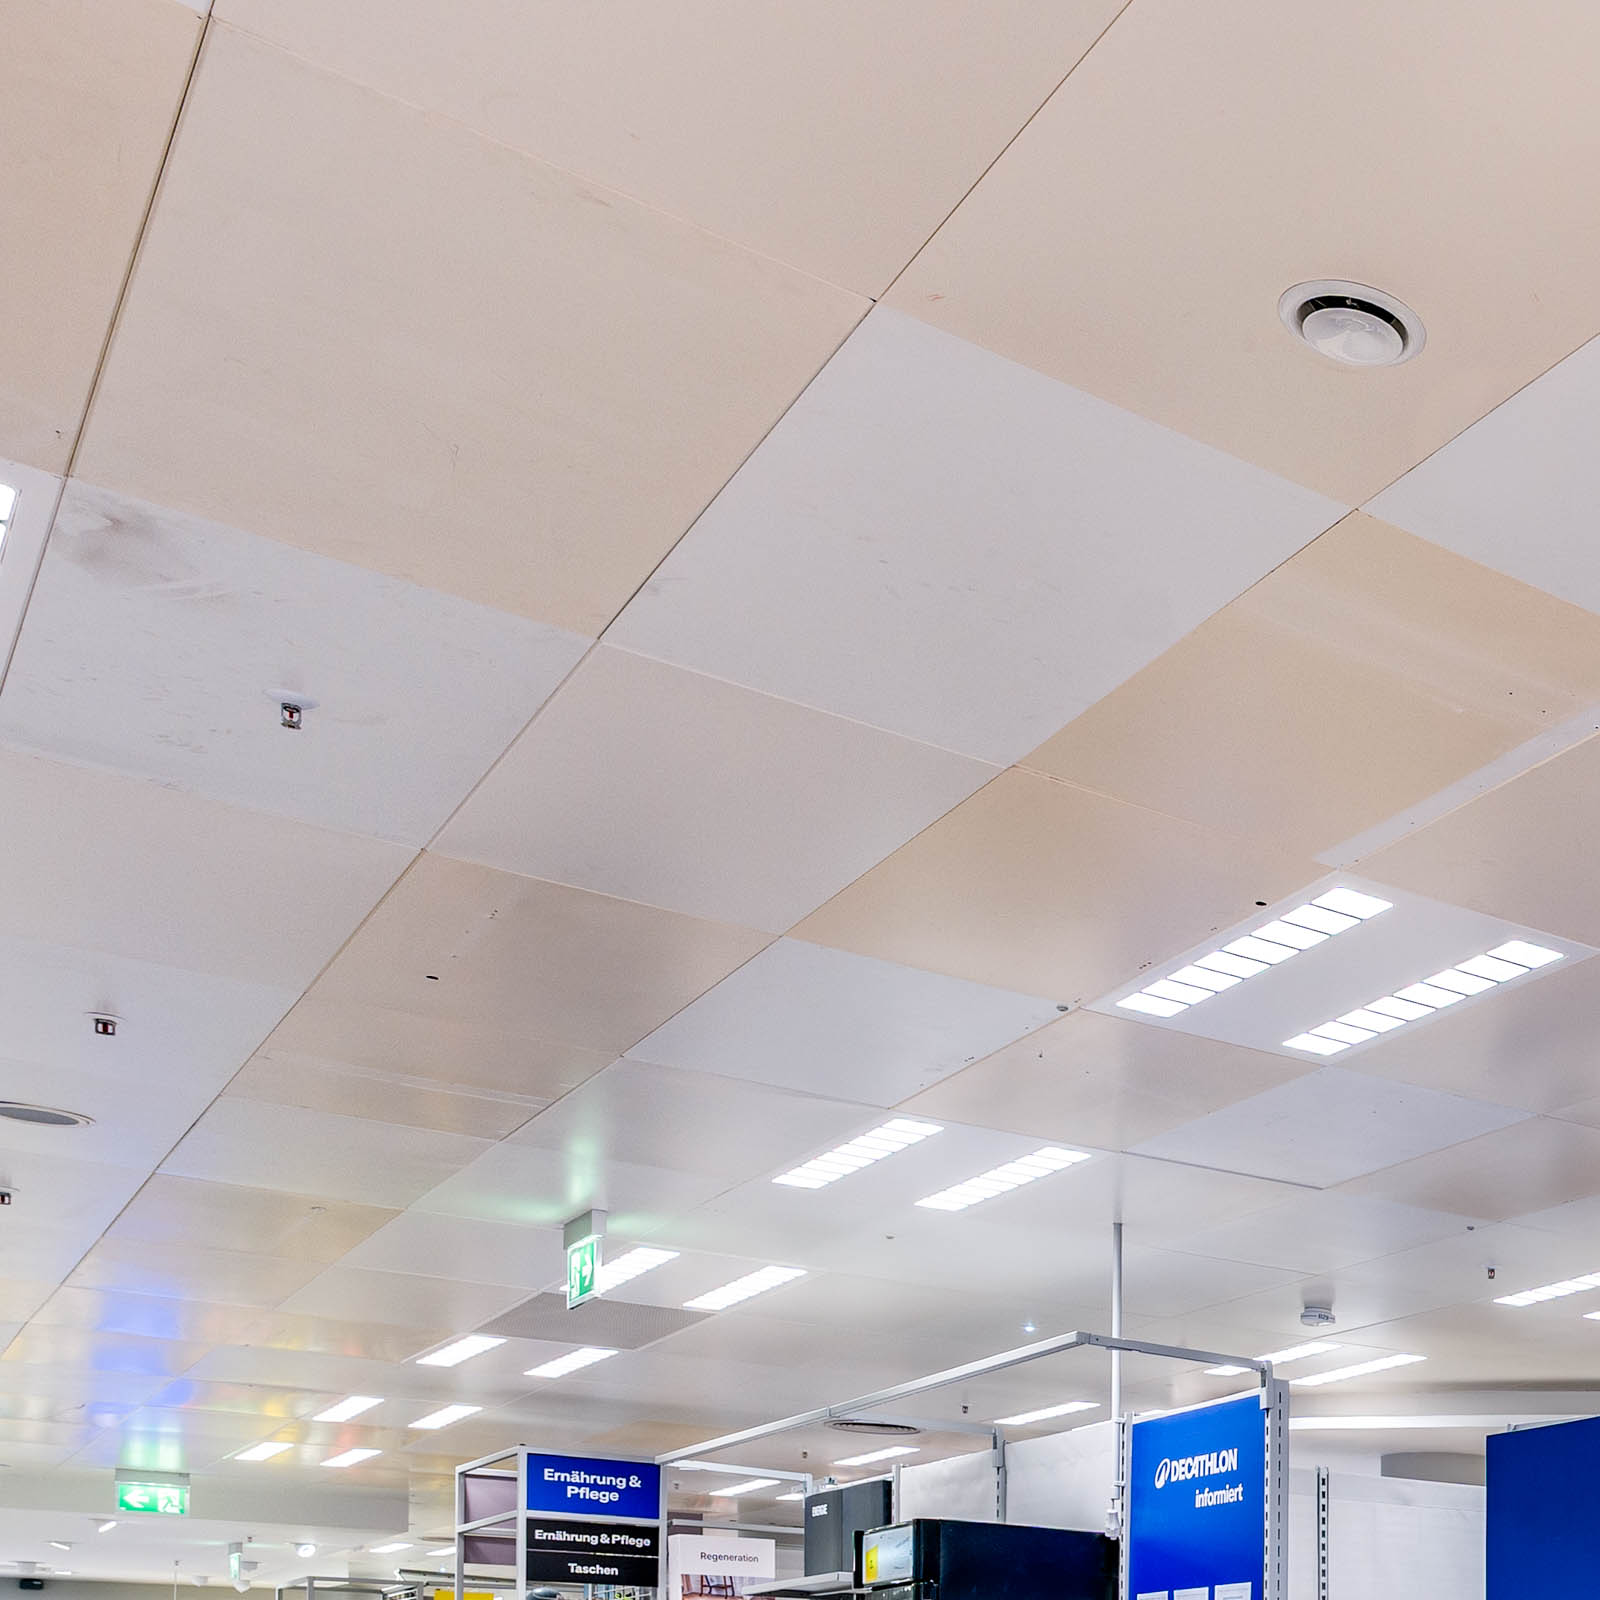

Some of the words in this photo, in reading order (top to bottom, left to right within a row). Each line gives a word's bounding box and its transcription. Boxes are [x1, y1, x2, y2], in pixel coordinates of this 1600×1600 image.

[1170, 1448, 1238, 1482] DECATHLON
[543, 1468, 627, 1489] Ernährung
[629, 1475, 642, 1488] &
[567, 1486, 620, 1503] Pflege
[1195, 1483, 1243, 1508] informiert
[534, 1529, 599, 1545] Ernährung
[600, 1533, 611, 1544] &
[611, 1534, 651, 1548] Pflege
[700, 1551, 759, 1563] Regeneration
[568, 1563, 619, 1576] Taschen
